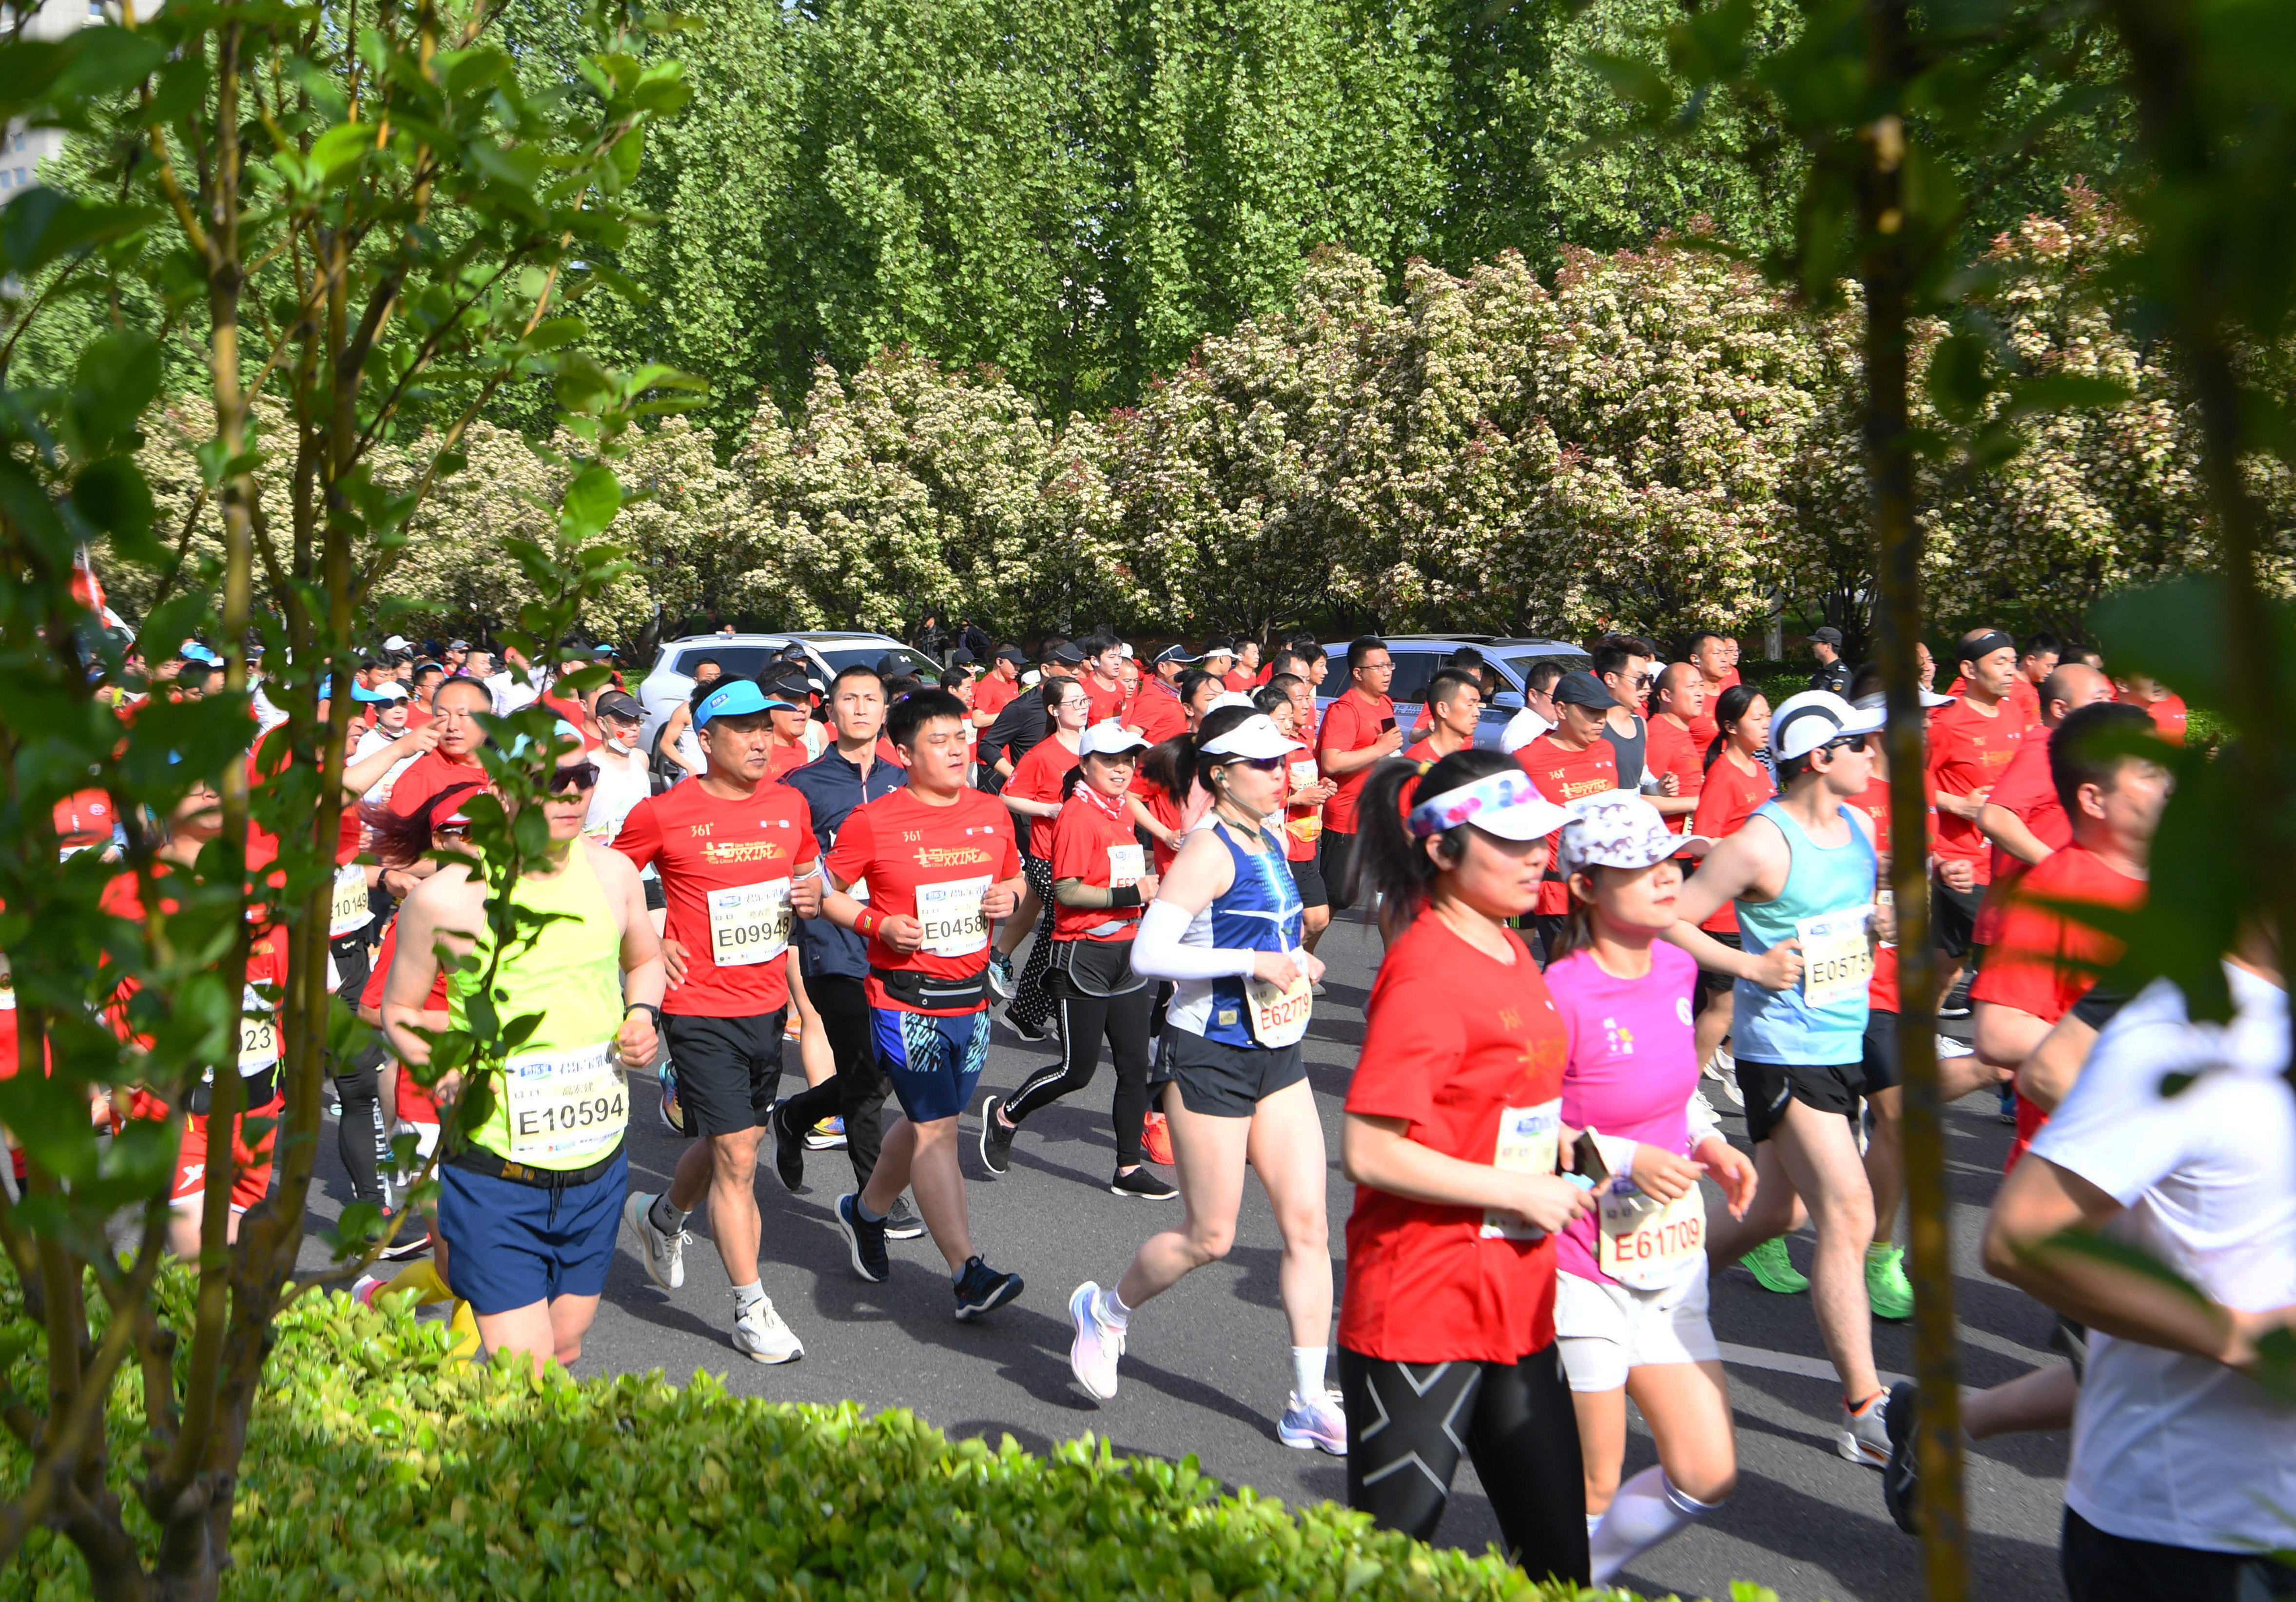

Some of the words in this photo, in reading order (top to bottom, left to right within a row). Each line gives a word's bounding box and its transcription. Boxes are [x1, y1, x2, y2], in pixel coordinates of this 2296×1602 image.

[331, 893, 367, 920] 10149
[719, 917, 789, 947] E09948
[925, 915, 988, 939] E04586
[1261, 993, 1309, 1030] E62779
[519, 1093, 624, 1136] E10594
[1615, 1218, 1699, 1261] E61709
